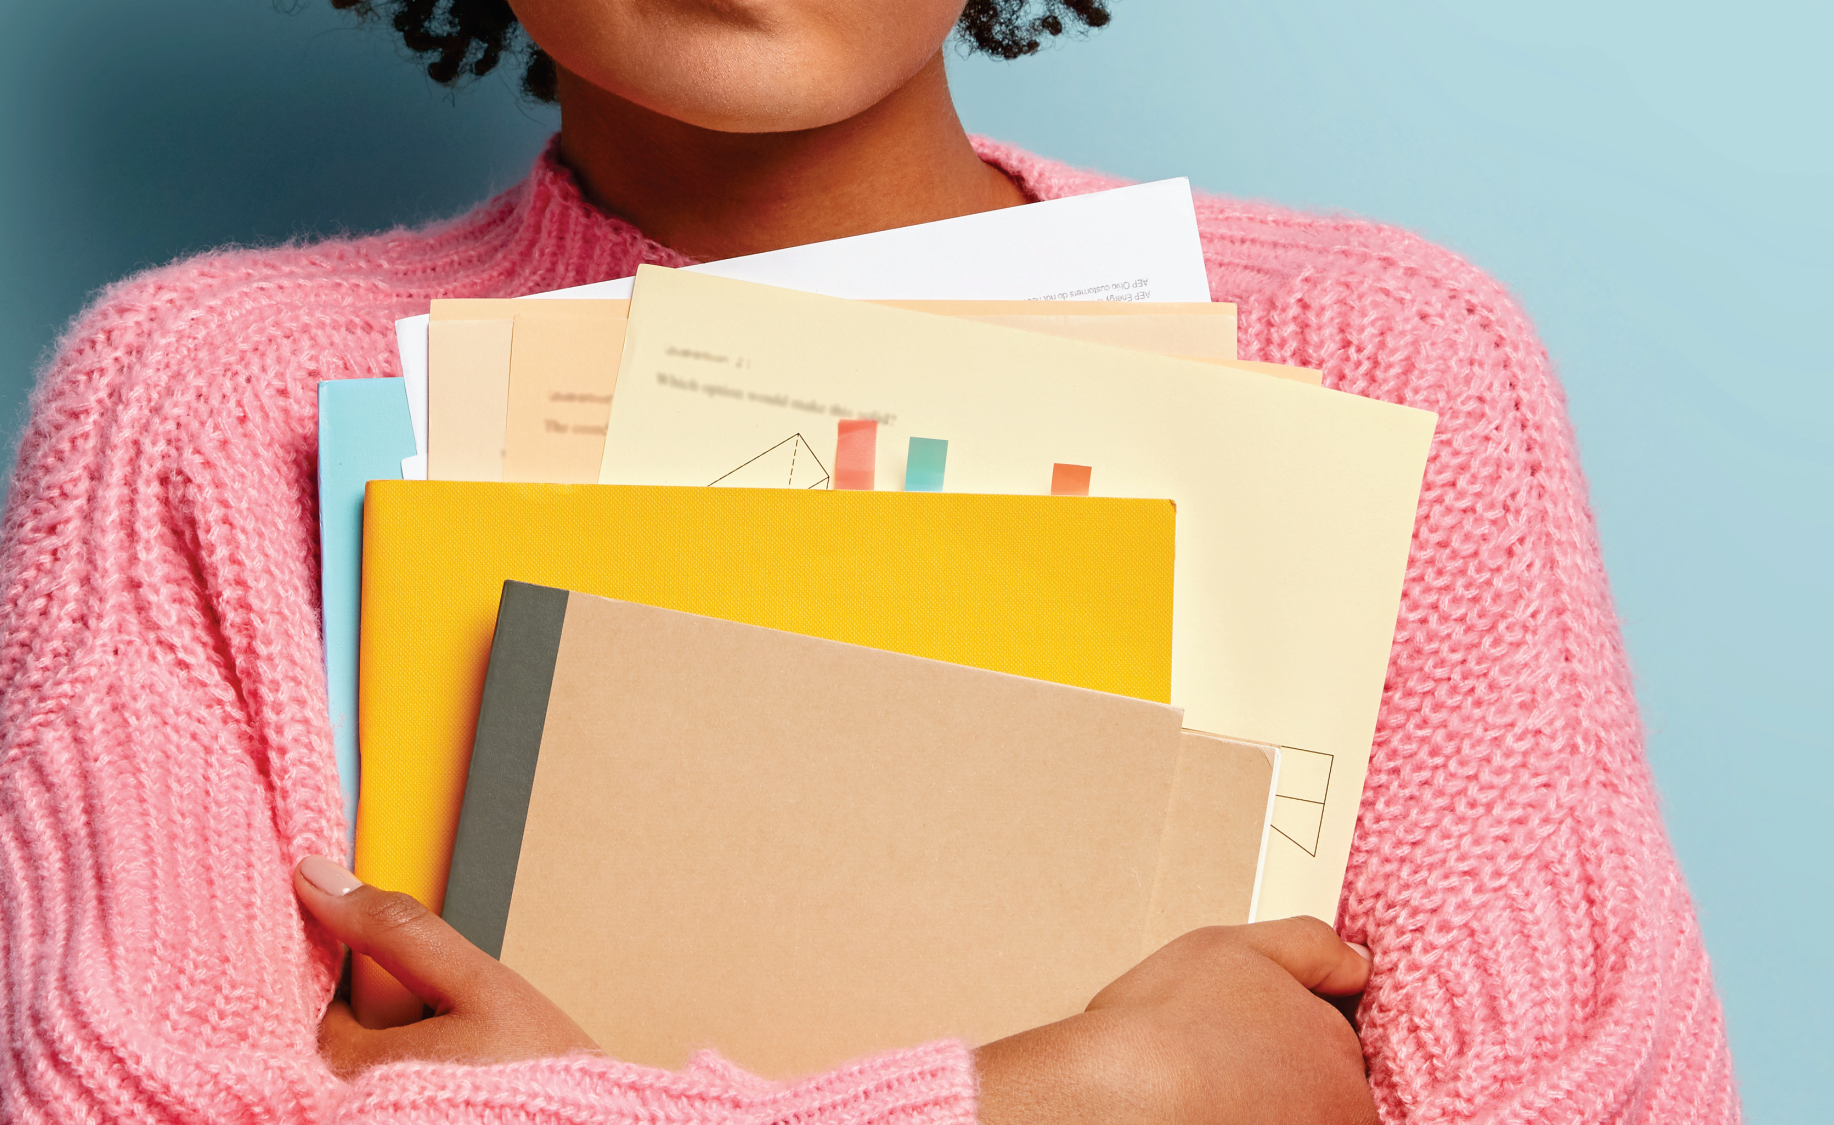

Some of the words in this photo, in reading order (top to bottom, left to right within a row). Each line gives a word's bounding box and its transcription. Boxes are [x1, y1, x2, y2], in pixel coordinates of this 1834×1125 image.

[1112, 281, 1130, 291] Ohio
[1132, 278, 1148, 288] AEP
[1070, 284, 1110, 297] customers
[1134, 290, 1151, 300] AEP
[1058, 292, 1068, 300] do
